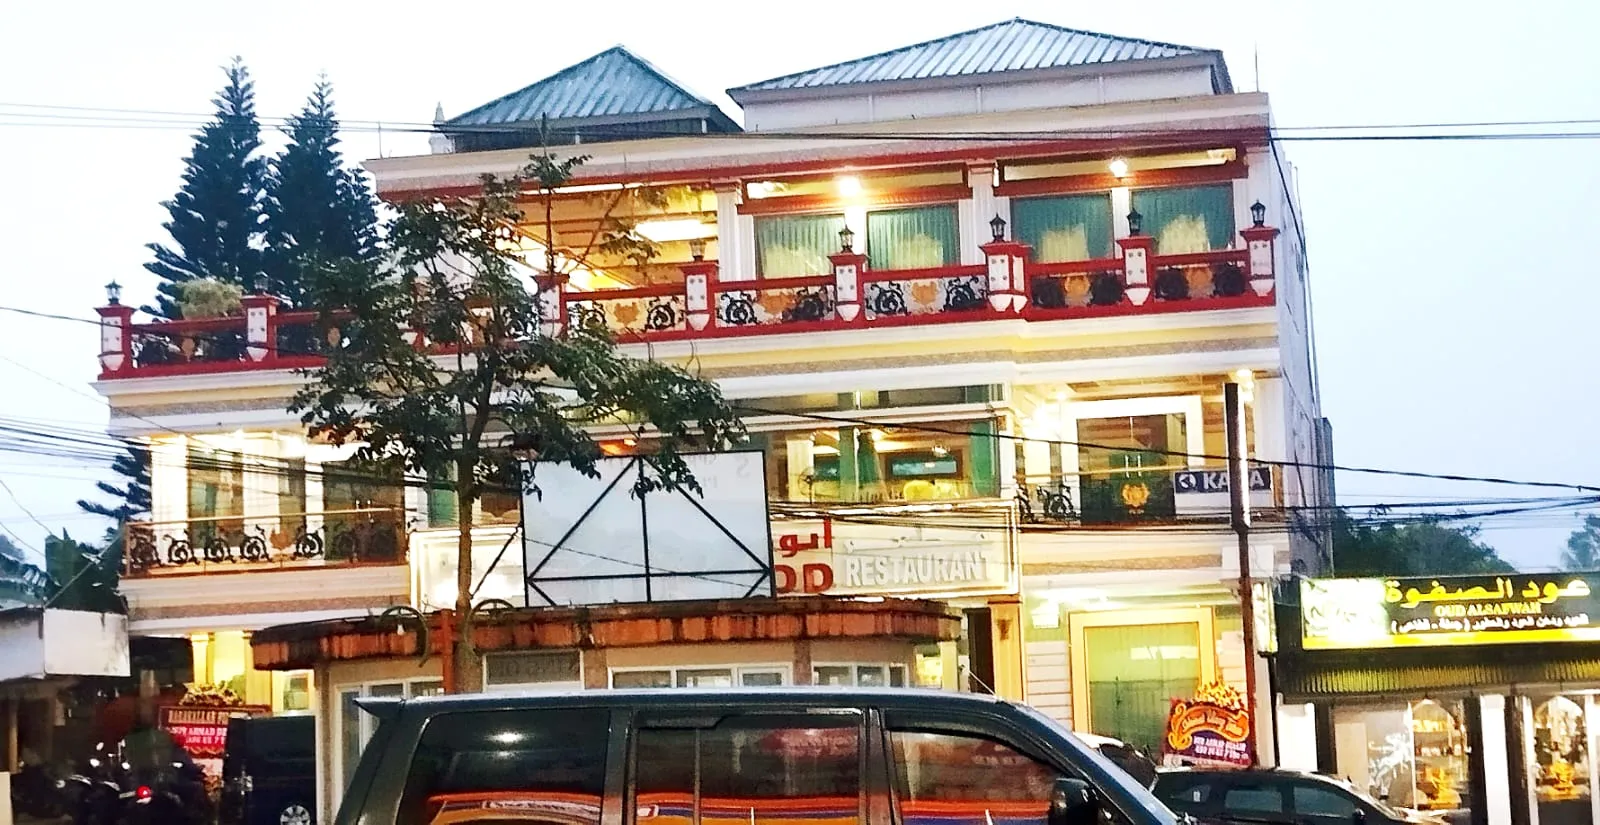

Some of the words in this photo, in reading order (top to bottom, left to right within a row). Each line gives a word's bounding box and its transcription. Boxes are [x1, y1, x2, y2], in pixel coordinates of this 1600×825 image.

[1203, 469, 1264, 490] KAA
[775, 562, 835, 594] OD
[844, 550, 991, 588] RESTAURANT
[1385, 576, 1514, 608] الصفوة
[1522, 578, 1591, 604] عود
[1434, 603, 1467, 617] OUD
[1466, 600, 1542, 616] ALSAFWAH
